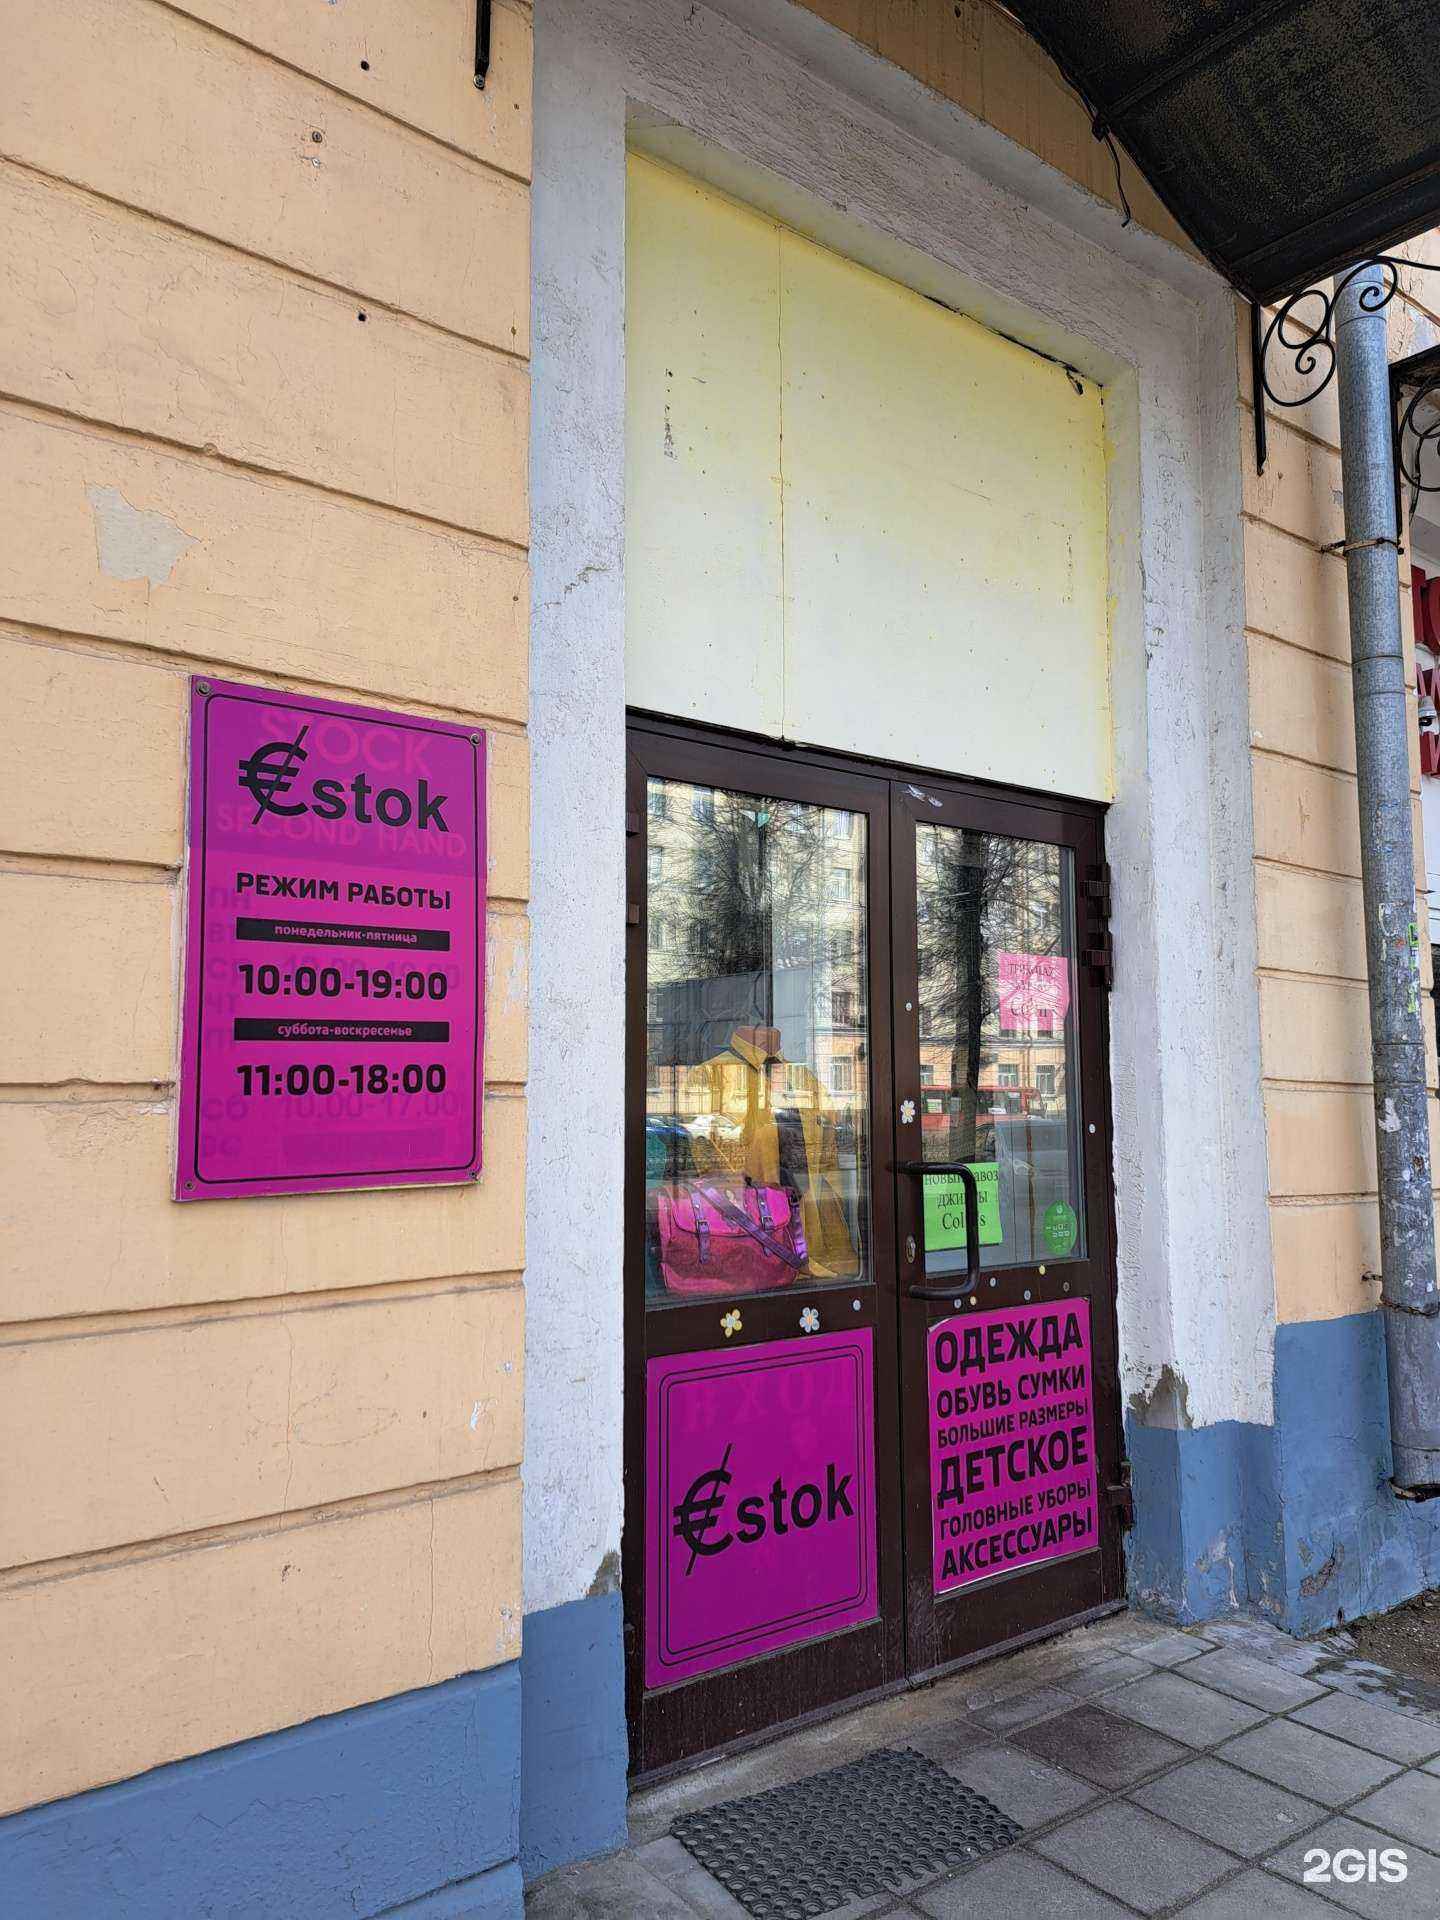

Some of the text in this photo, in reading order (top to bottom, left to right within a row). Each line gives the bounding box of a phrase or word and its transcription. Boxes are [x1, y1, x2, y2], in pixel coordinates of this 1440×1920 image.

[236, 872, 339, 901] РЕЖИМ
[348, 882, 450, 910] РАБОТЫ
[274, 925, 418, 944] понедельник-пятница
[238, 964, 448, 1001] 10:00-19:00
[277, 1022, 413, 1039] суббота-воскресенье
[236, 1064, 447, 1096] 11:00-18:00
[934, 1311, 1084, 1377] ОДЕЖДА
[936, 1364, 1086, 1419] ОБУВЬ СУМКИ
[937, 1397, 1089, 1449] БОЛЬШИЕ РАЗМЕРЫ
[936, 1425, 1089, 1510] ДЕТСКОЕ
[939, 1478, 1092, 1541] ГОЛОВНЫЕ УБОРЫ
[940, 1507, 1093, 1581] АКСЕССУАРЫ
